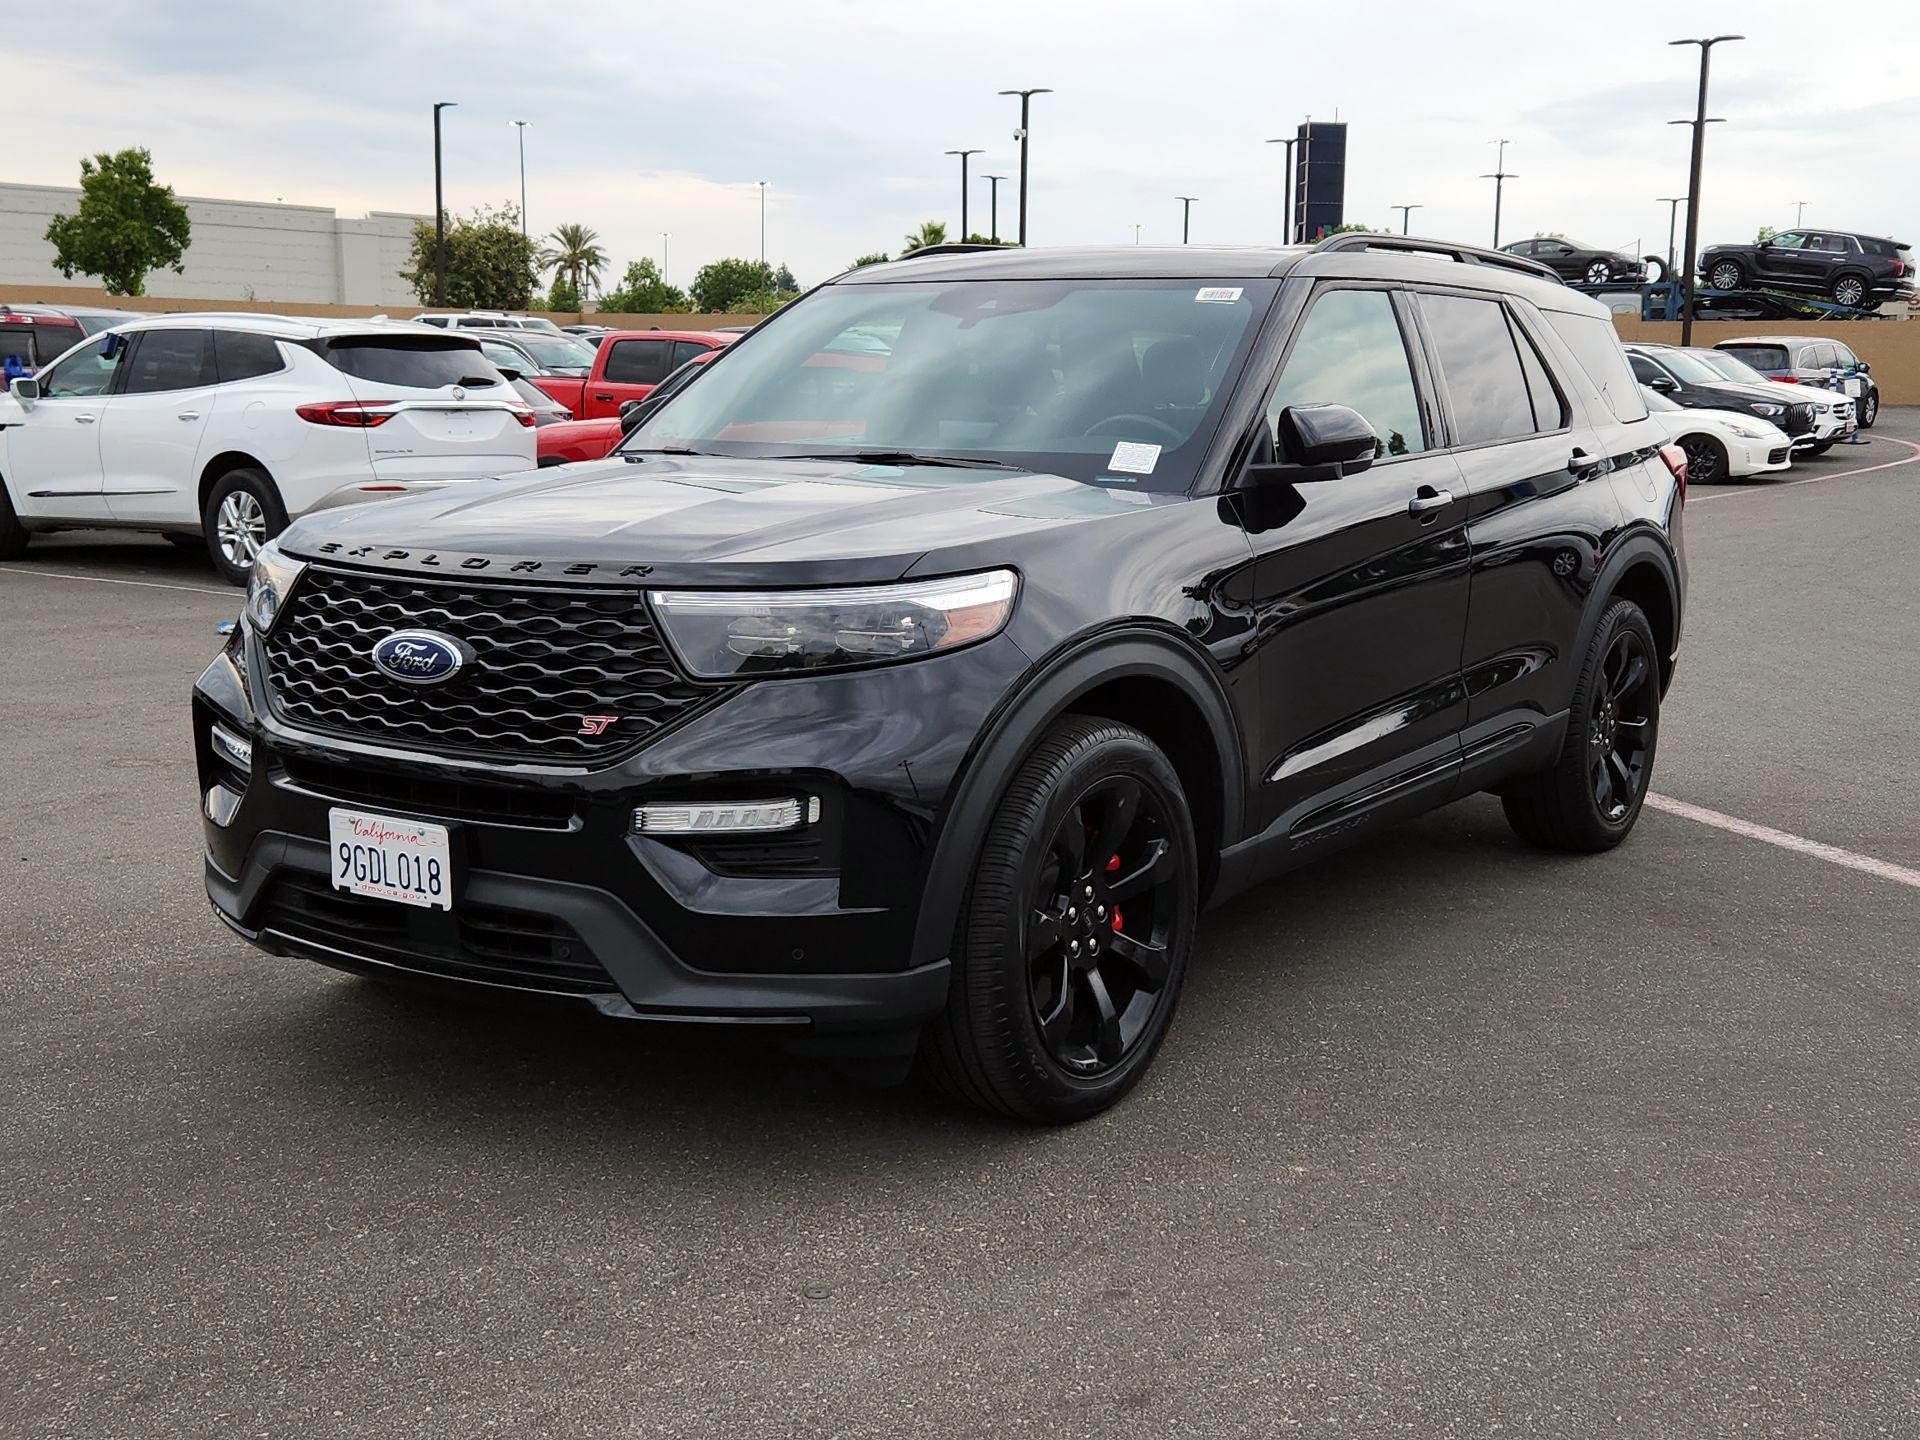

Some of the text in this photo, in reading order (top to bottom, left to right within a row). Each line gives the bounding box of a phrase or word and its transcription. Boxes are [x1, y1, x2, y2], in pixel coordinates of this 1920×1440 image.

[318, 542, 655, 577] EXPLORER
[388, 641, 438, 672] Ford
[578, 715, 619, 735] ST
[354, 818, 426, 846] California
[339, 842, 441, 895] 9GDL018
[361, 883, 421, 900] dmv.ca.gov
